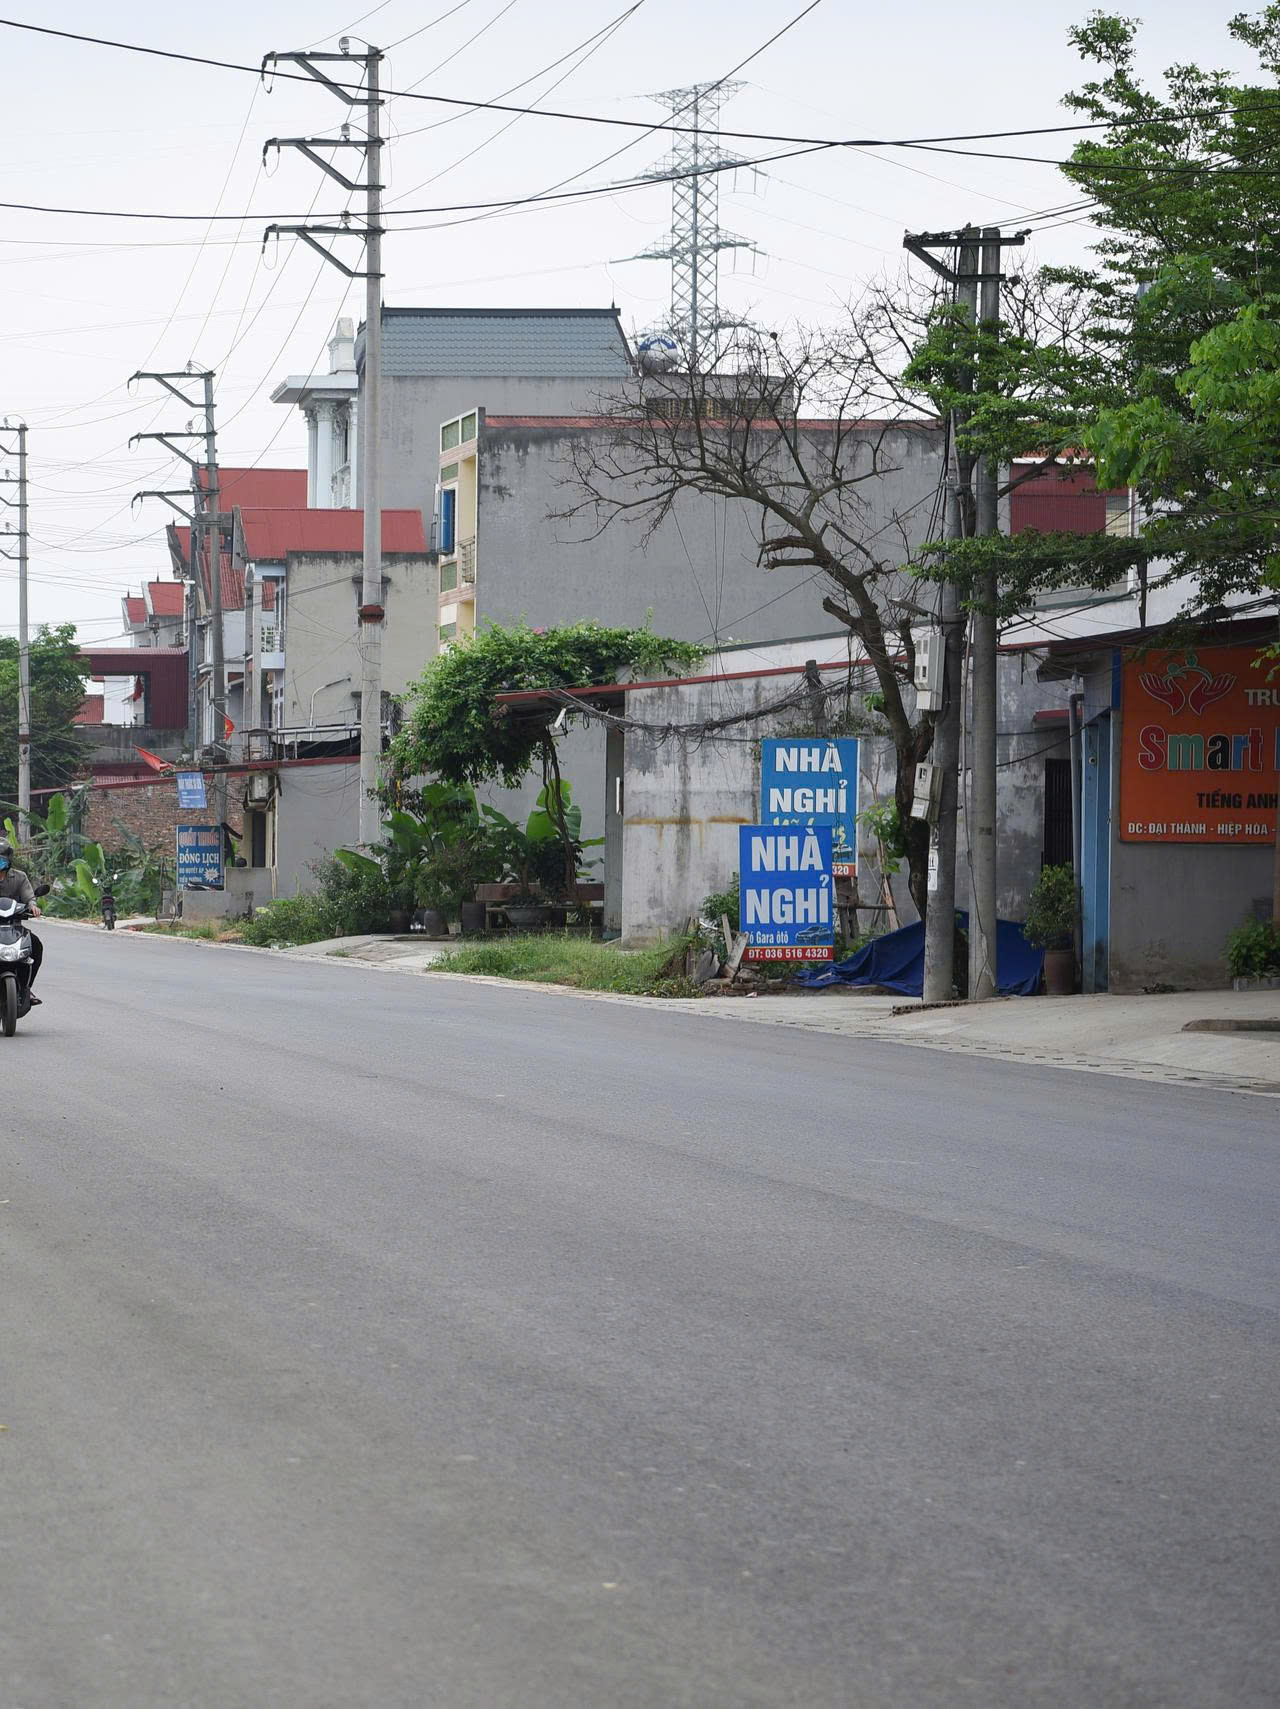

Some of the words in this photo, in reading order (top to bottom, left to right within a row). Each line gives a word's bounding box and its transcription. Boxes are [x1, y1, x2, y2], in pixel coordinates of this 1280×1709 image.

[776, 742, 842, 772] NHÀ
[1138, 724, 1263, 772] Smart
[769, 779, 848, 813] NGHỈ
[1197, 789, 1242, 809] TIẾNG
[1247, 793, 1278, 809] ANH
[1170, 820, 1206, 834] THÀNH
[1217, 821, 1242, 836] HIỆP
[751, 827, 824, 872] NHÀ
[746, 874, 829, 925] NGHỈ
[756, 930, 774, 944] Gara
[748, 948, 764, 959] ĐT:
[765, 948, 784, 959] 036
[785, 948, 803, 959] 516
[805, 948, 828, 958] 4320
